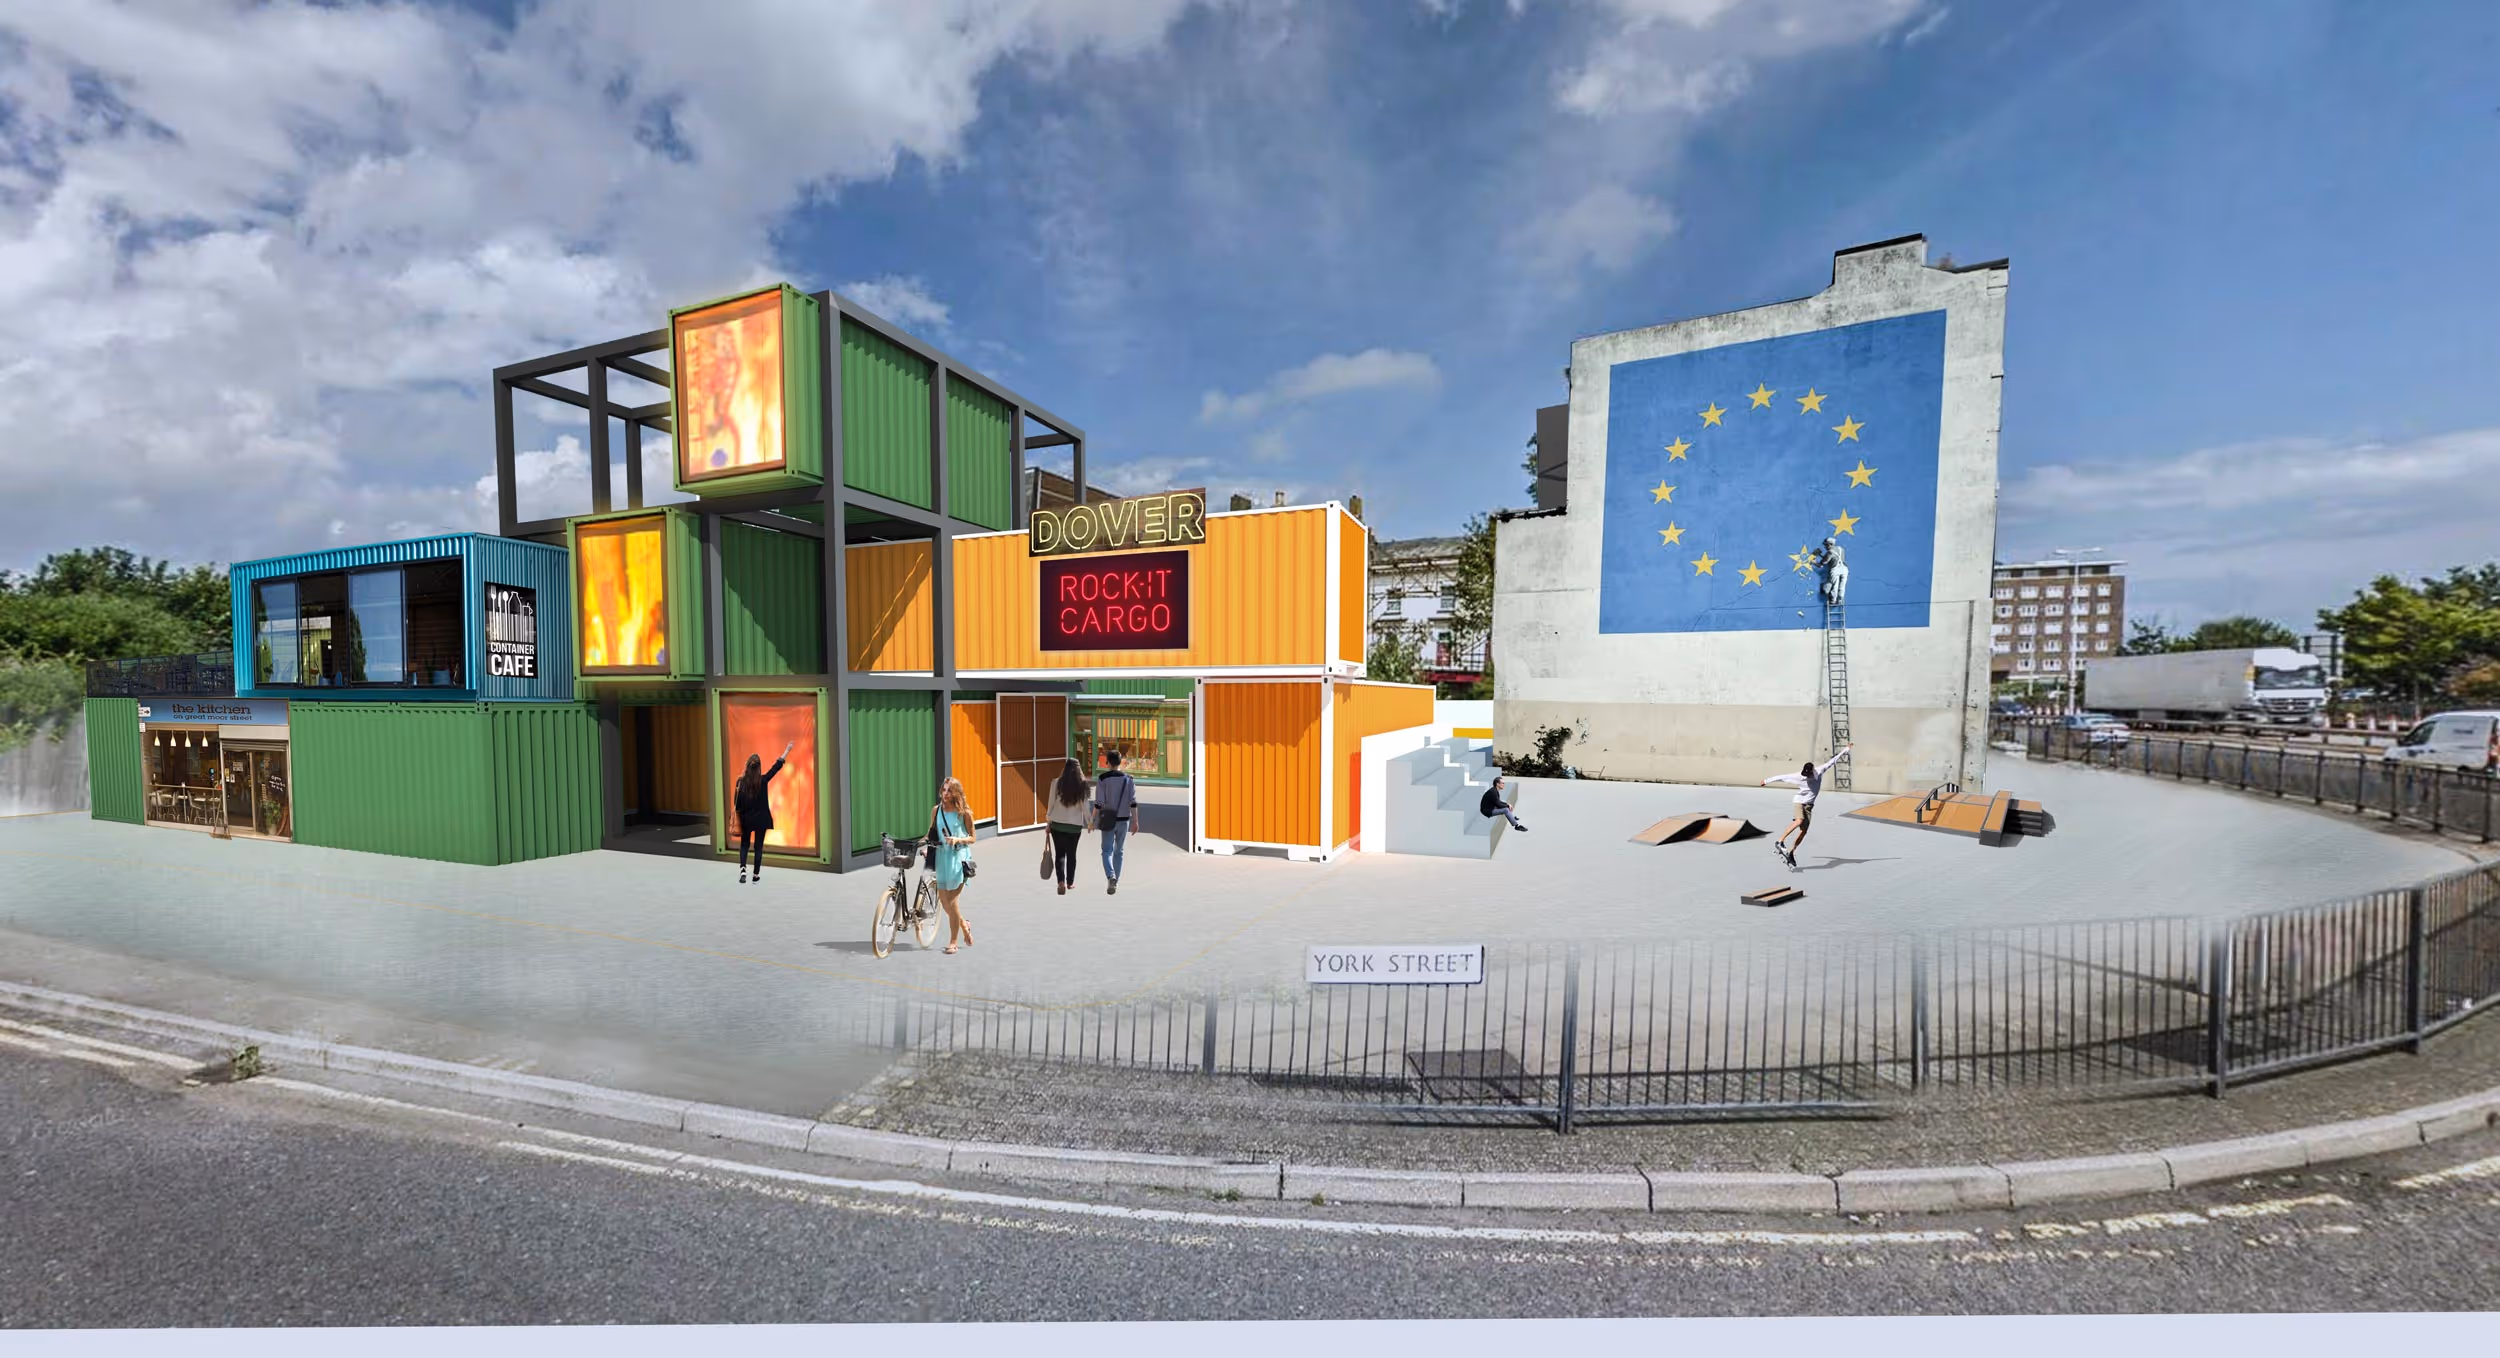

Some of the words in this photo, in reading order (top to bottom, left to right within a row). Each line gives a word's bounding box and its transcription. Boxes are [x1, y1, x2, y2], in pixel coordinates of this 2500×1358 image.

[1031, 493, 1205, 553] DOVER
[1060, 569, 1172, 602] ROCK-IT
[1060, 603, 1171, 634] CARGO
[490, 641, 535, 655] CONTAINER
[491, 654, 534, 676] CAFE
[172, 703, 194, 713] the
[197, 703, 252, 715] kitchen
[185, 713, 206, 721] great
[1313, 953, 1375, 973] YORK
[1388, 953, 1474, 973] STREET
